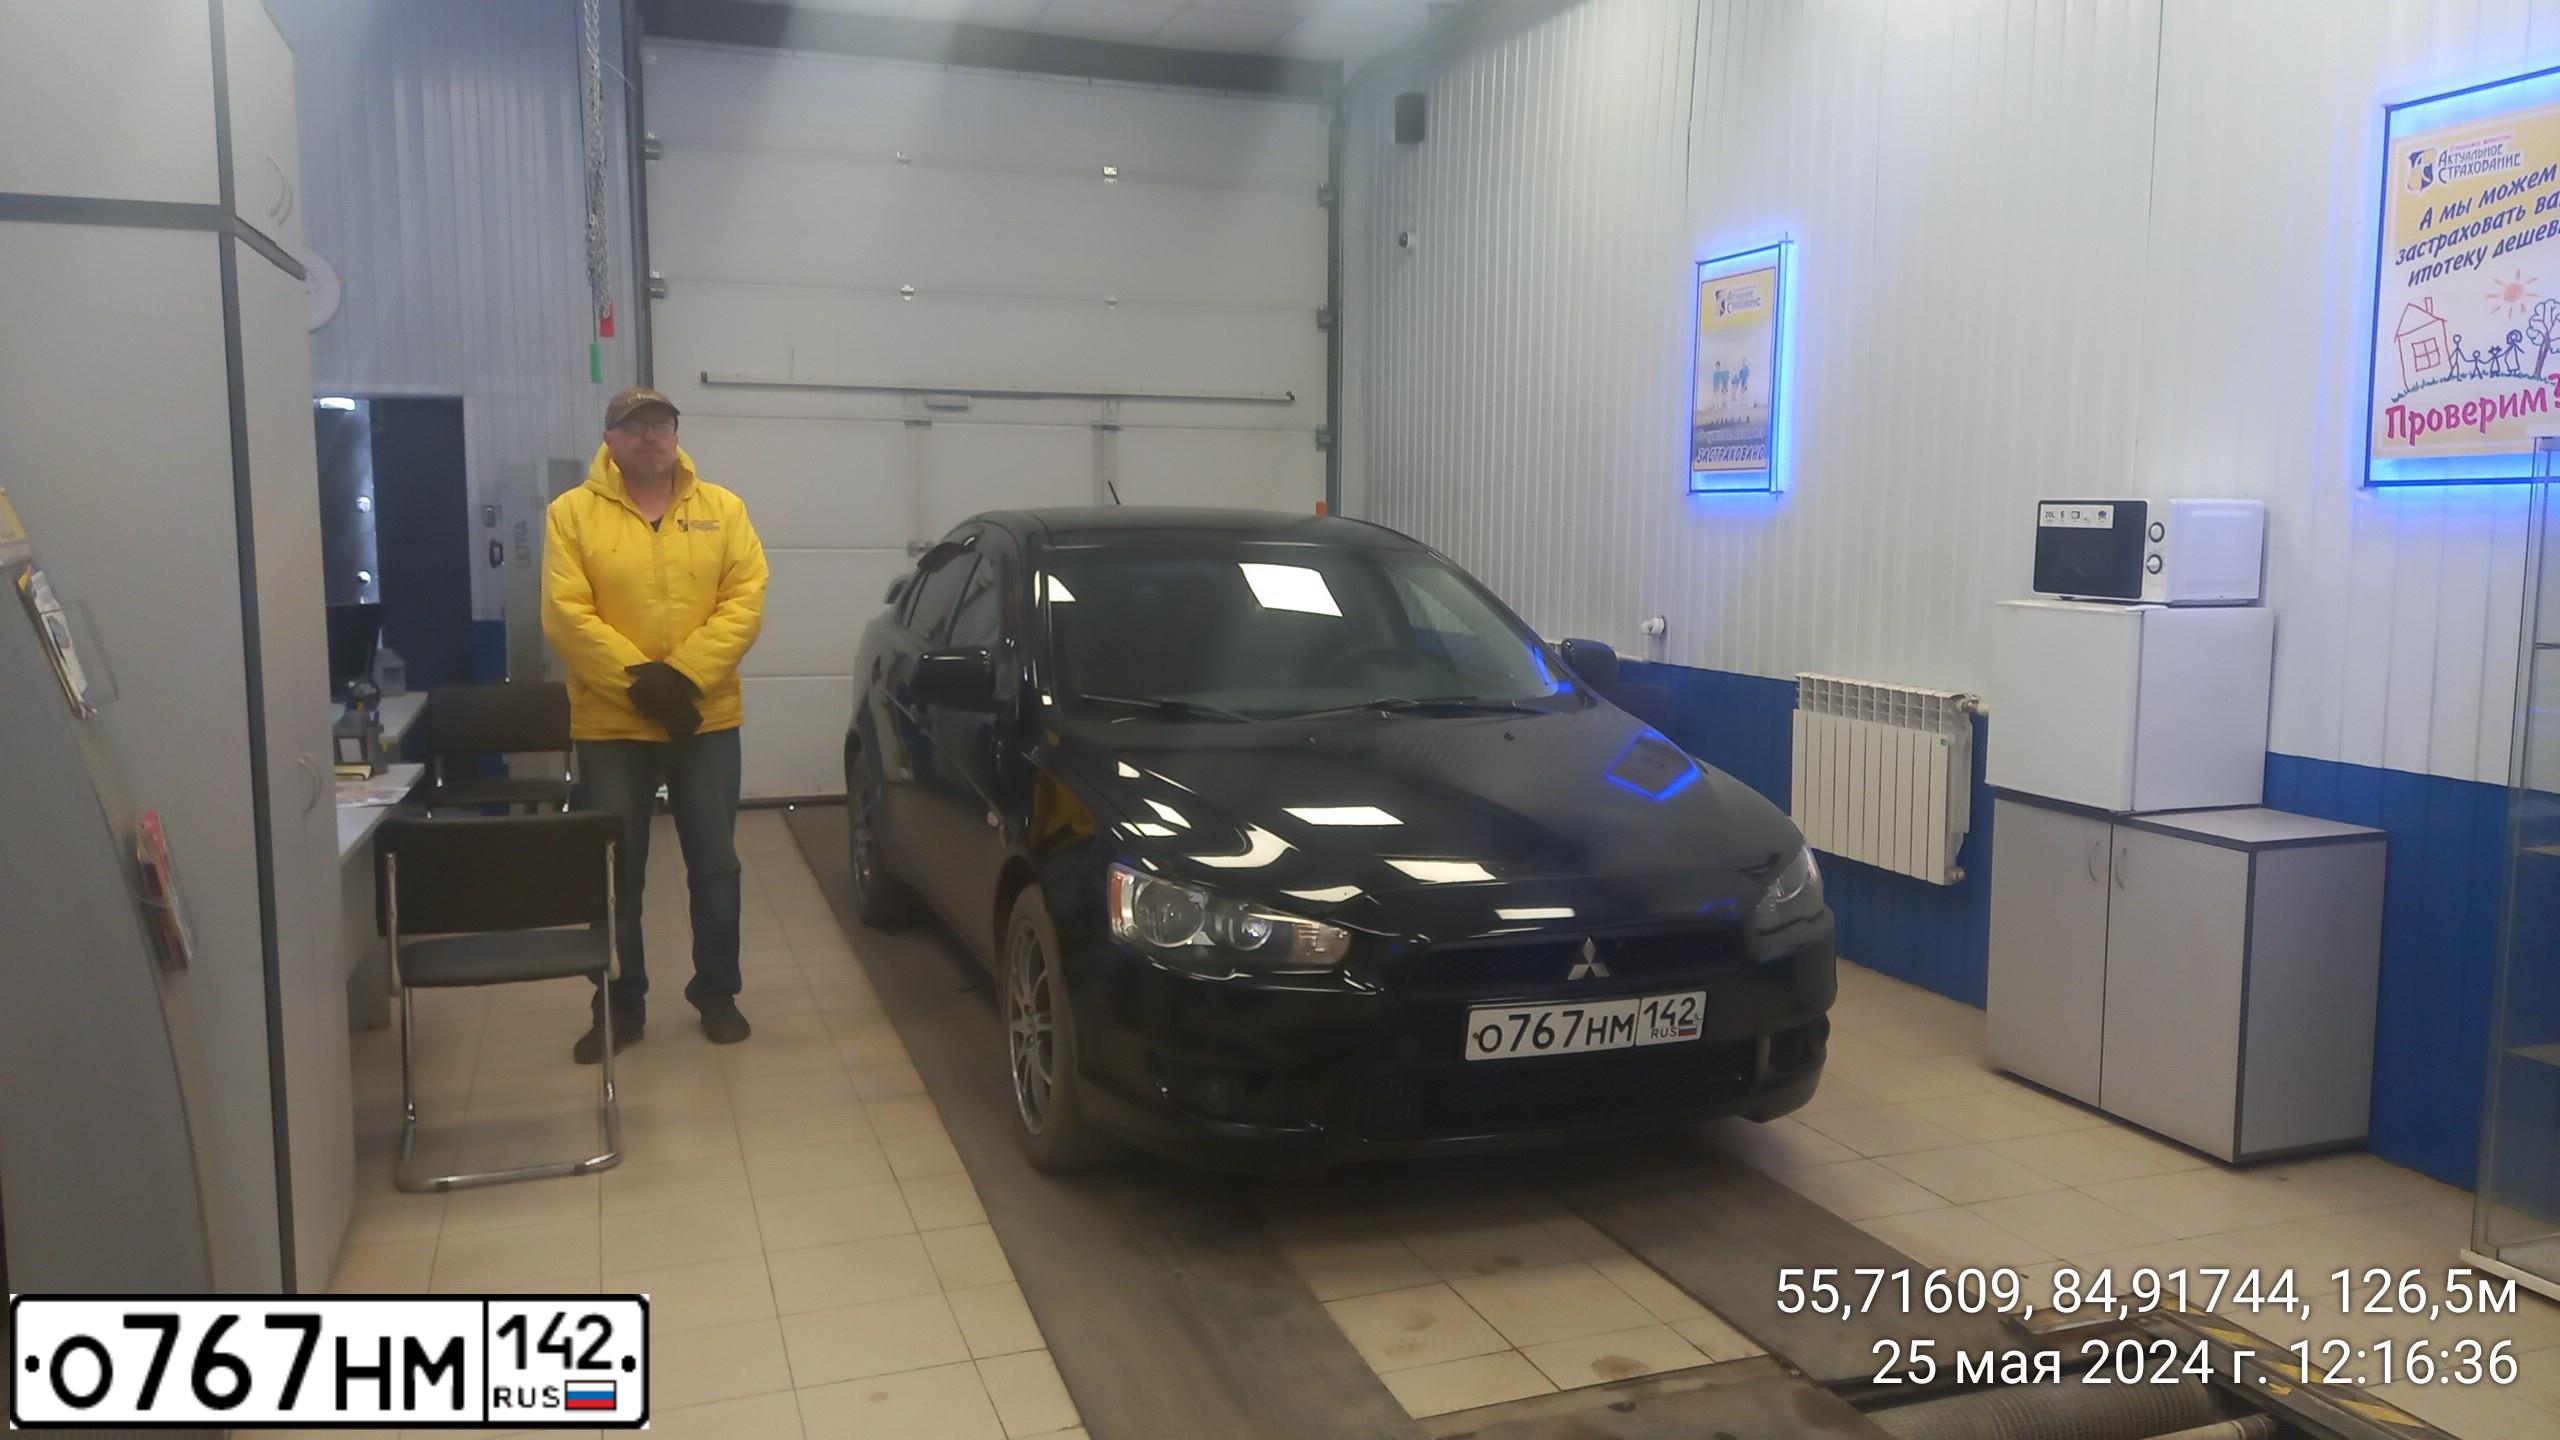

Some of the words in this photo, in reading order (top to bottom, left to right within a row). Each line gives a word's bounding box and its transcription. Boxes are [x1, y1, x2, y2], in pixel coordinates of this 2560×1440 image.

[2395, 205, 2526, 266] застраховать
[2534, 190, 2560, 215] ва
[2420, 207, 2433, 231] А
[2439, 198, 2472, 223] мы
[2478, 164, 2557, 208] можем
[2408, 245, 2488, 287] ипотеку
[2492, 219, 2560, 259] дешев
[1643, 997, 1697, 1028] 142
[1651, 1027, 1678, 1039] RUS
